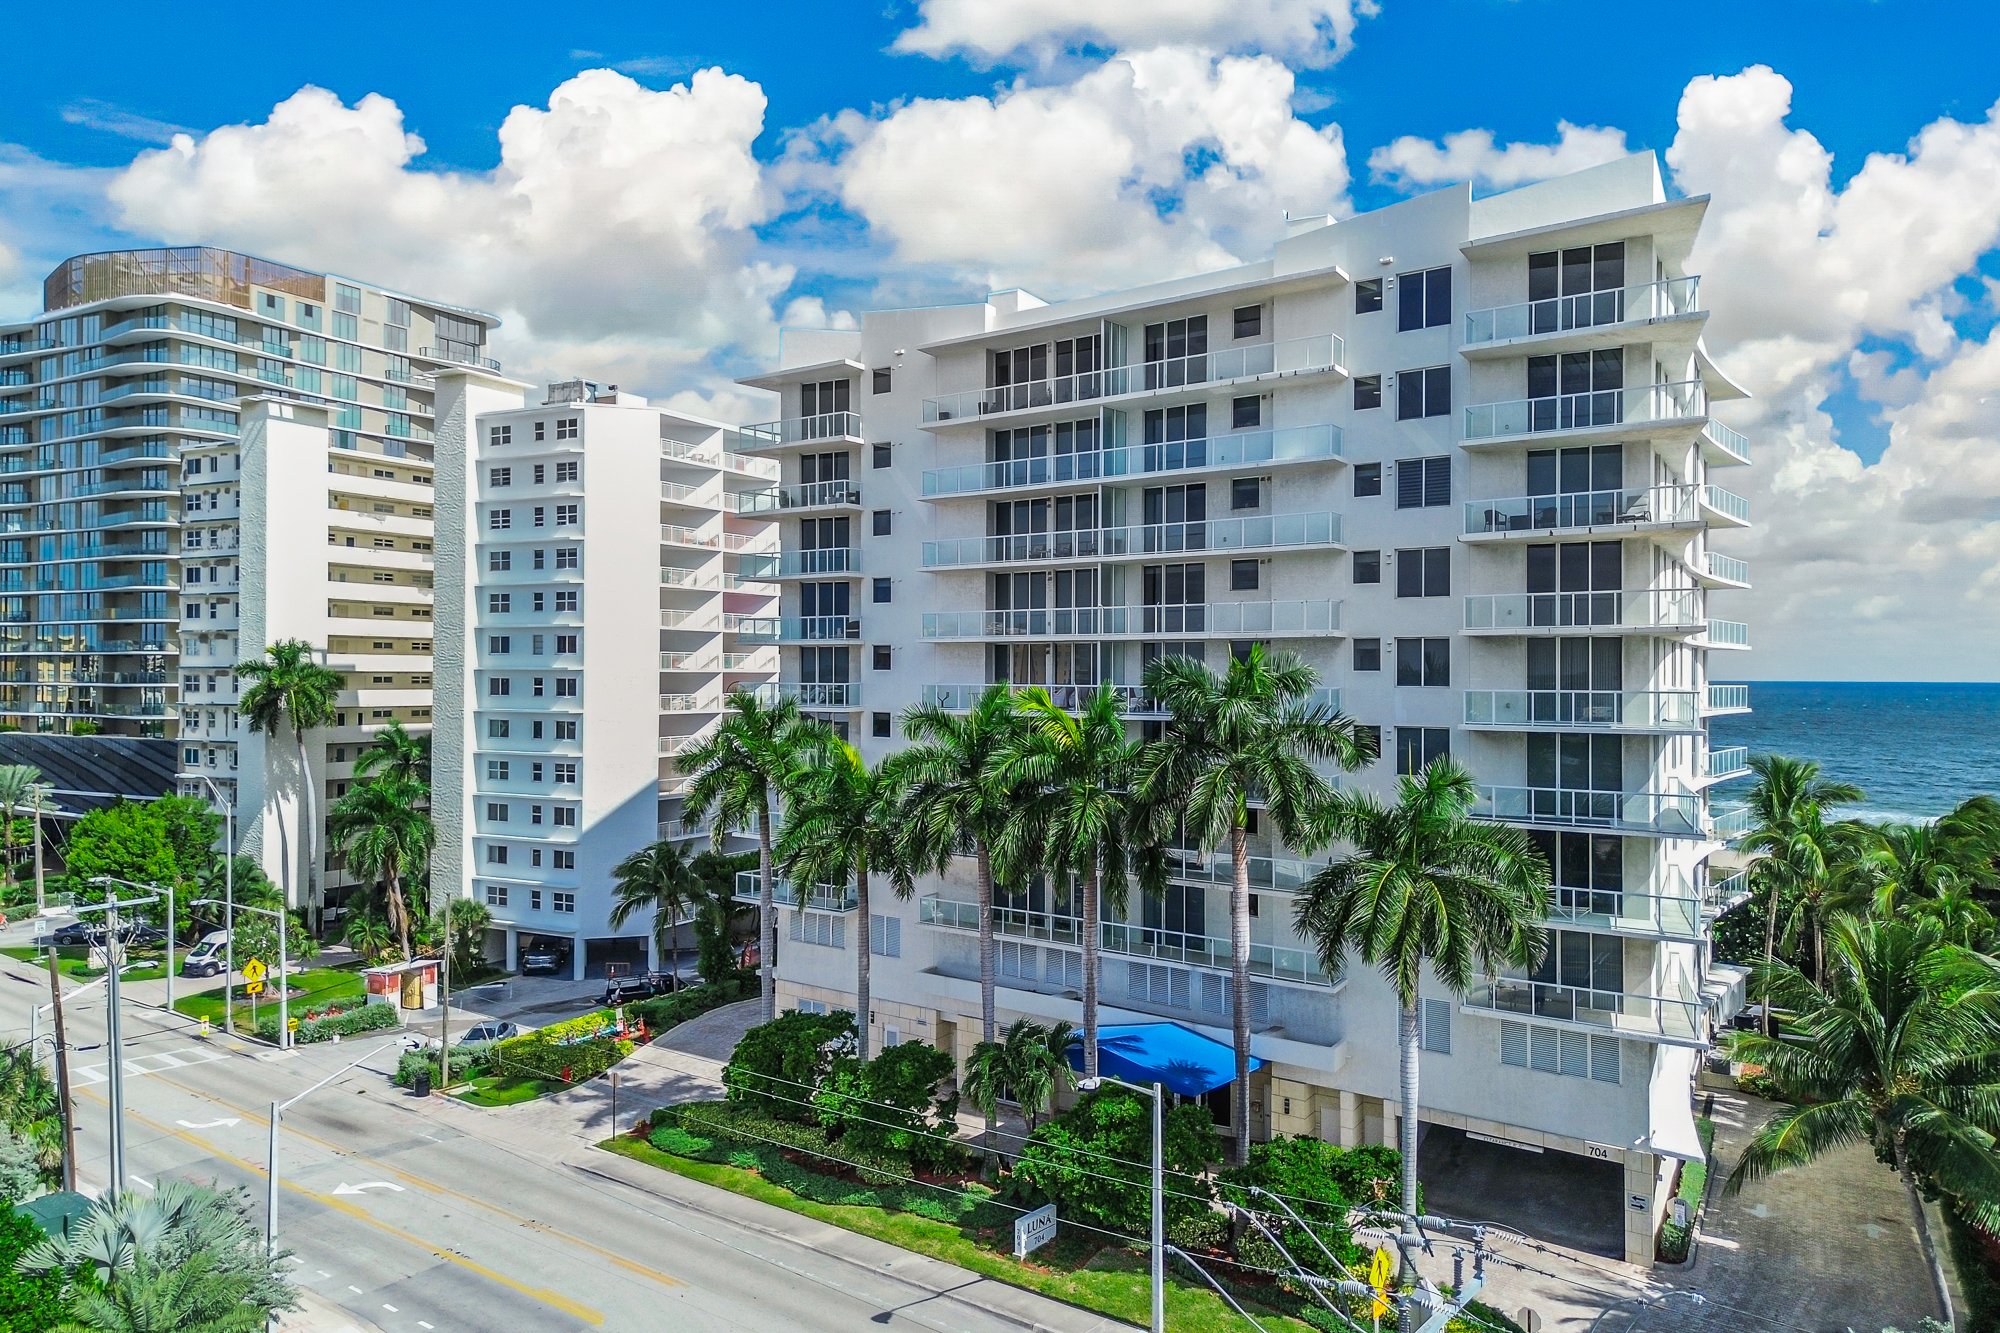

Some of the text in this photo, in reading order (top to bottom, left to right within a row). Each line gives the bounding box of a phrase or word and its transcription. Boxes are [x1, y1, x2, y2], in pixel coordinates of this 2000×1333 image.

[1588, 1146, 1608, 1159] 704
[1027, 1214, 1051, 1234] LUNA
[1033, 1233, 1045, 1245] 704
